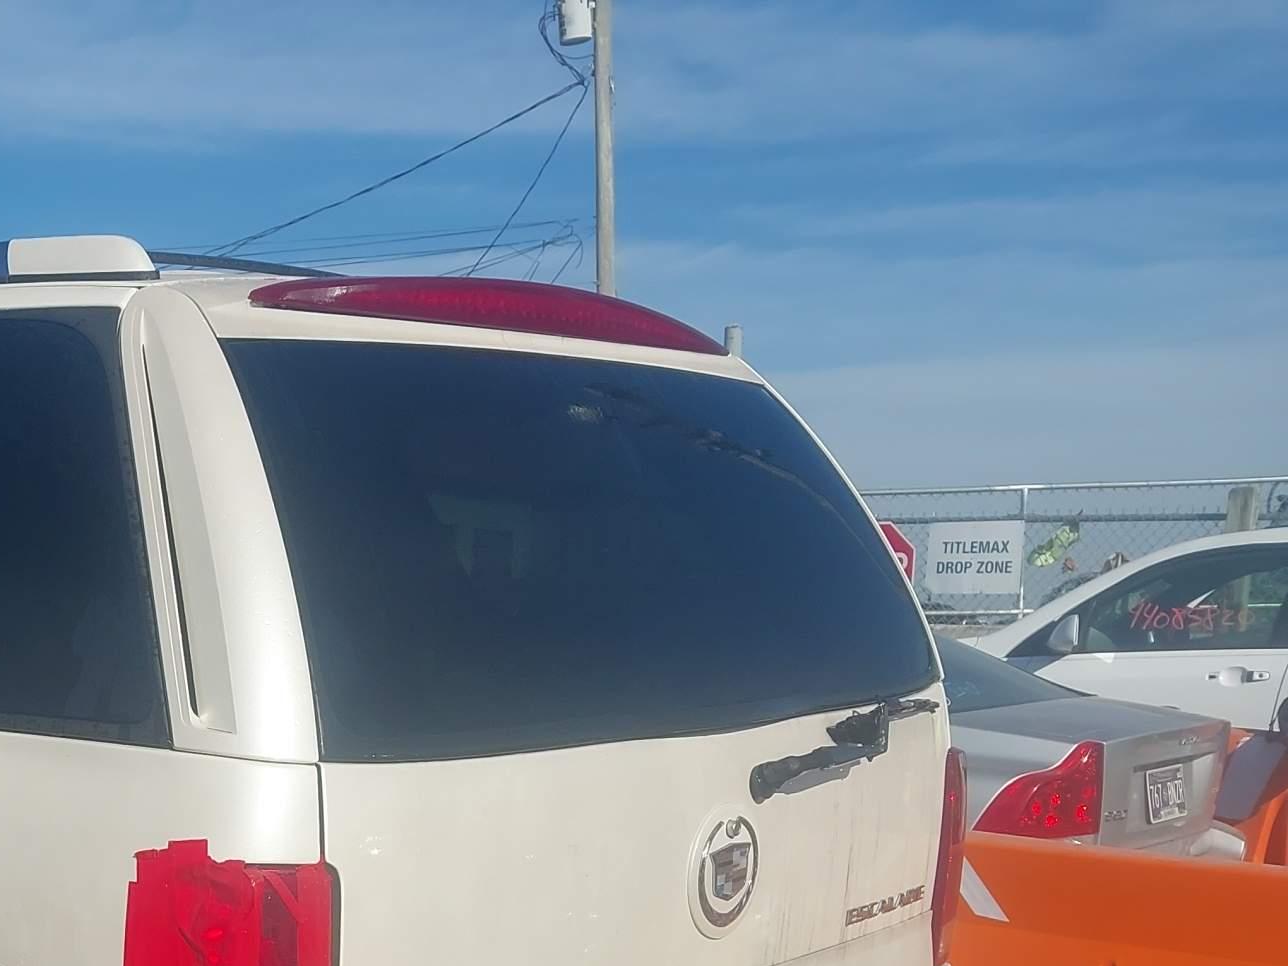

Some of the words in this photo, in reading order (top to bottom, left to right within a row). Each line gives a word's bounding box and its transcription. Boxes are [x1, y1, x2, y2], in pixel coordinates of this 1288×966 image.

[942, 540, 1010, 554] TITLEMAX
[936, 561, 972, 574] DROP
[976, 560, 1013, 574] ZONE
